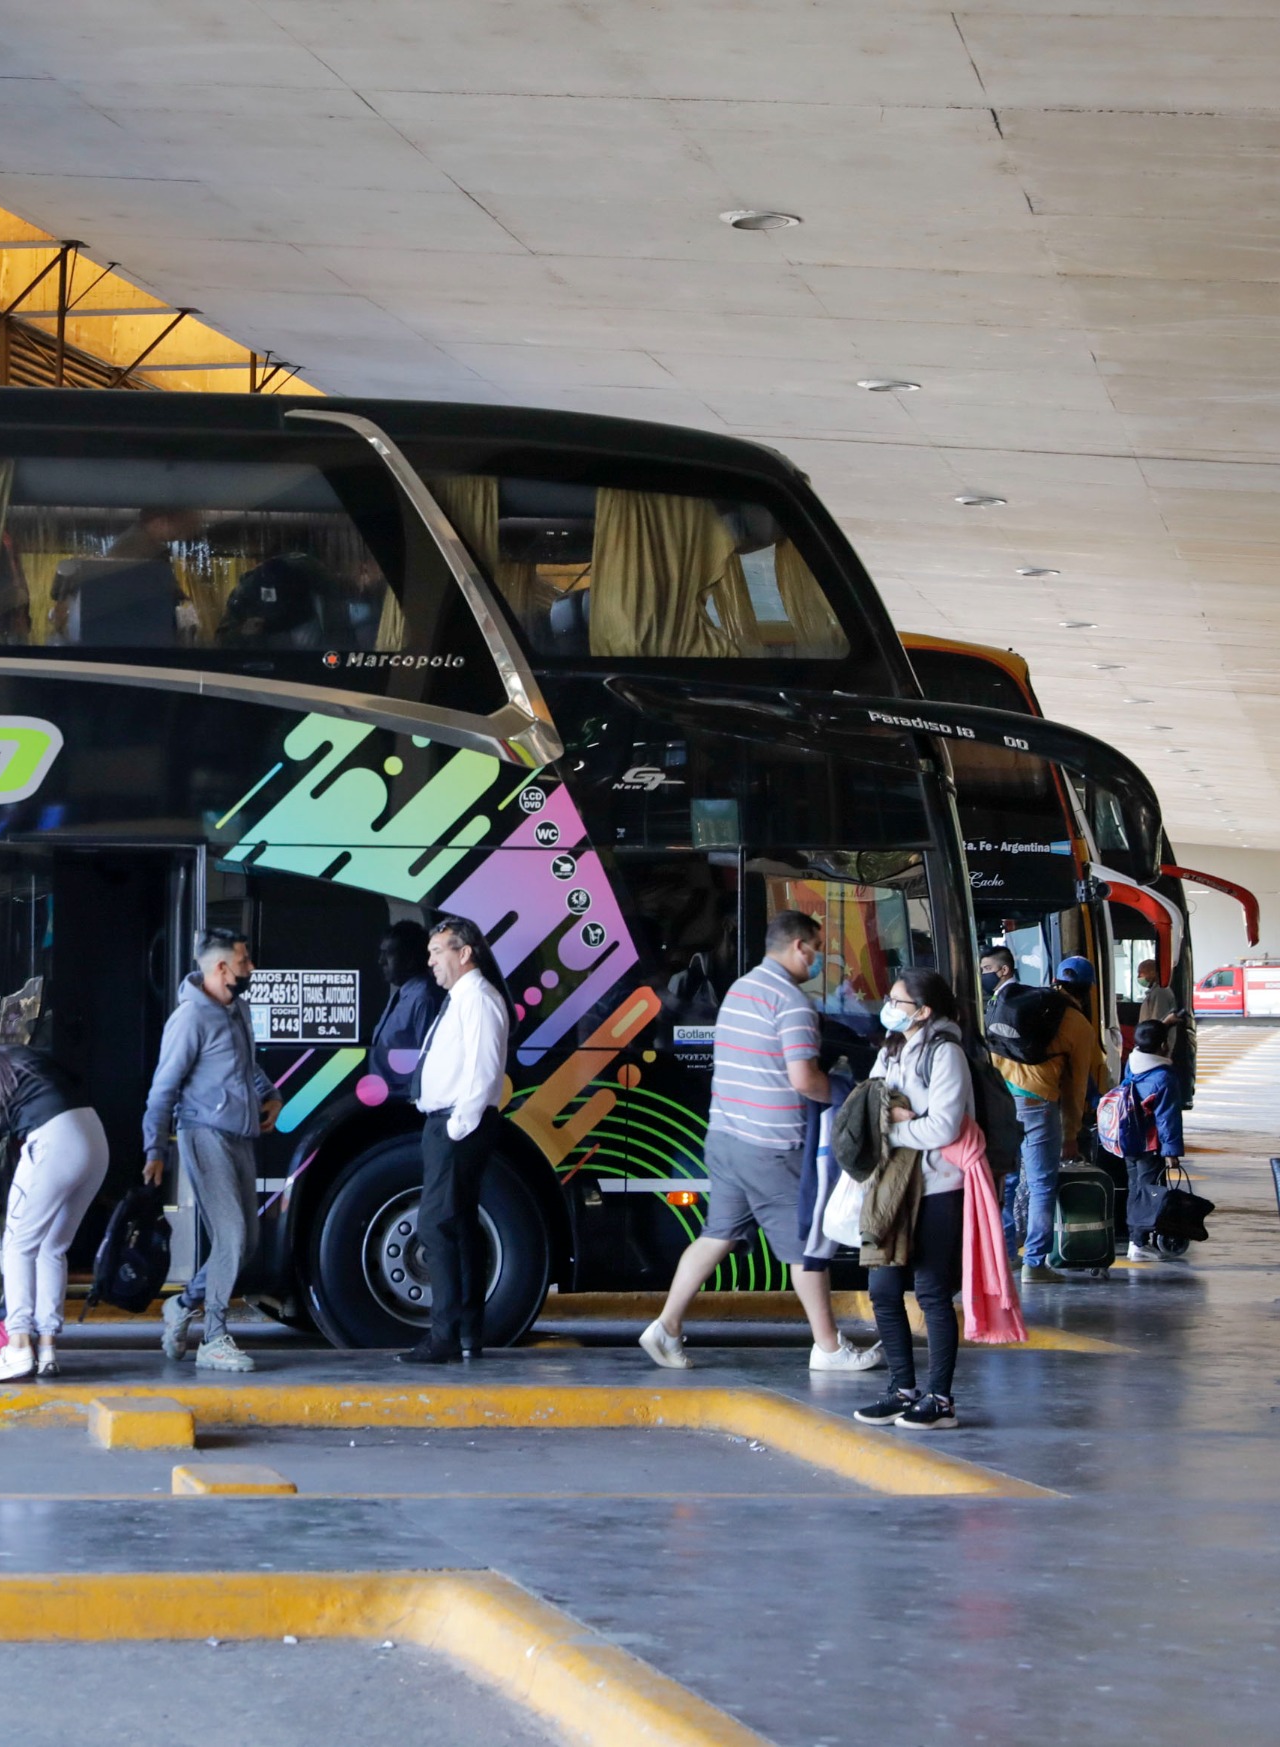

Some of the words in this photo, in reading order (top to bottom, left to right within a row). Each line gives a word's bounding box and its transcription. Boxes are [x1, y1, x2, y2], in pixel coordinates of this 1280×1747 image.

[346, 652, 465, 669] Marcopolo
[868, 711, 952, 734] Paradiso
[523, 792, 542, 800] LCD
[524, 801, 541, 809] DVD
[537, 828, 558, 840] WC
[980, 841, 992, 851] Fe
[1000, 842, 1050, 853] Argentina
[968, 871, 1005, 888] Cacho
[250, 973, 282, 983] AMOS
[284, 973, 298, 982] AL
[303, 974, 354, 985] EMPRESA
[303, 1006, 314, 1023] 20
[315, 1006, 327, 1023] DE
[328, 1006, 355, 1023] JUNIO
[272, 1018, 299, 1032] 3443
[318, 1026, 340, 1035] S.A.
[674, 1053, 714, 1061] VOLV
